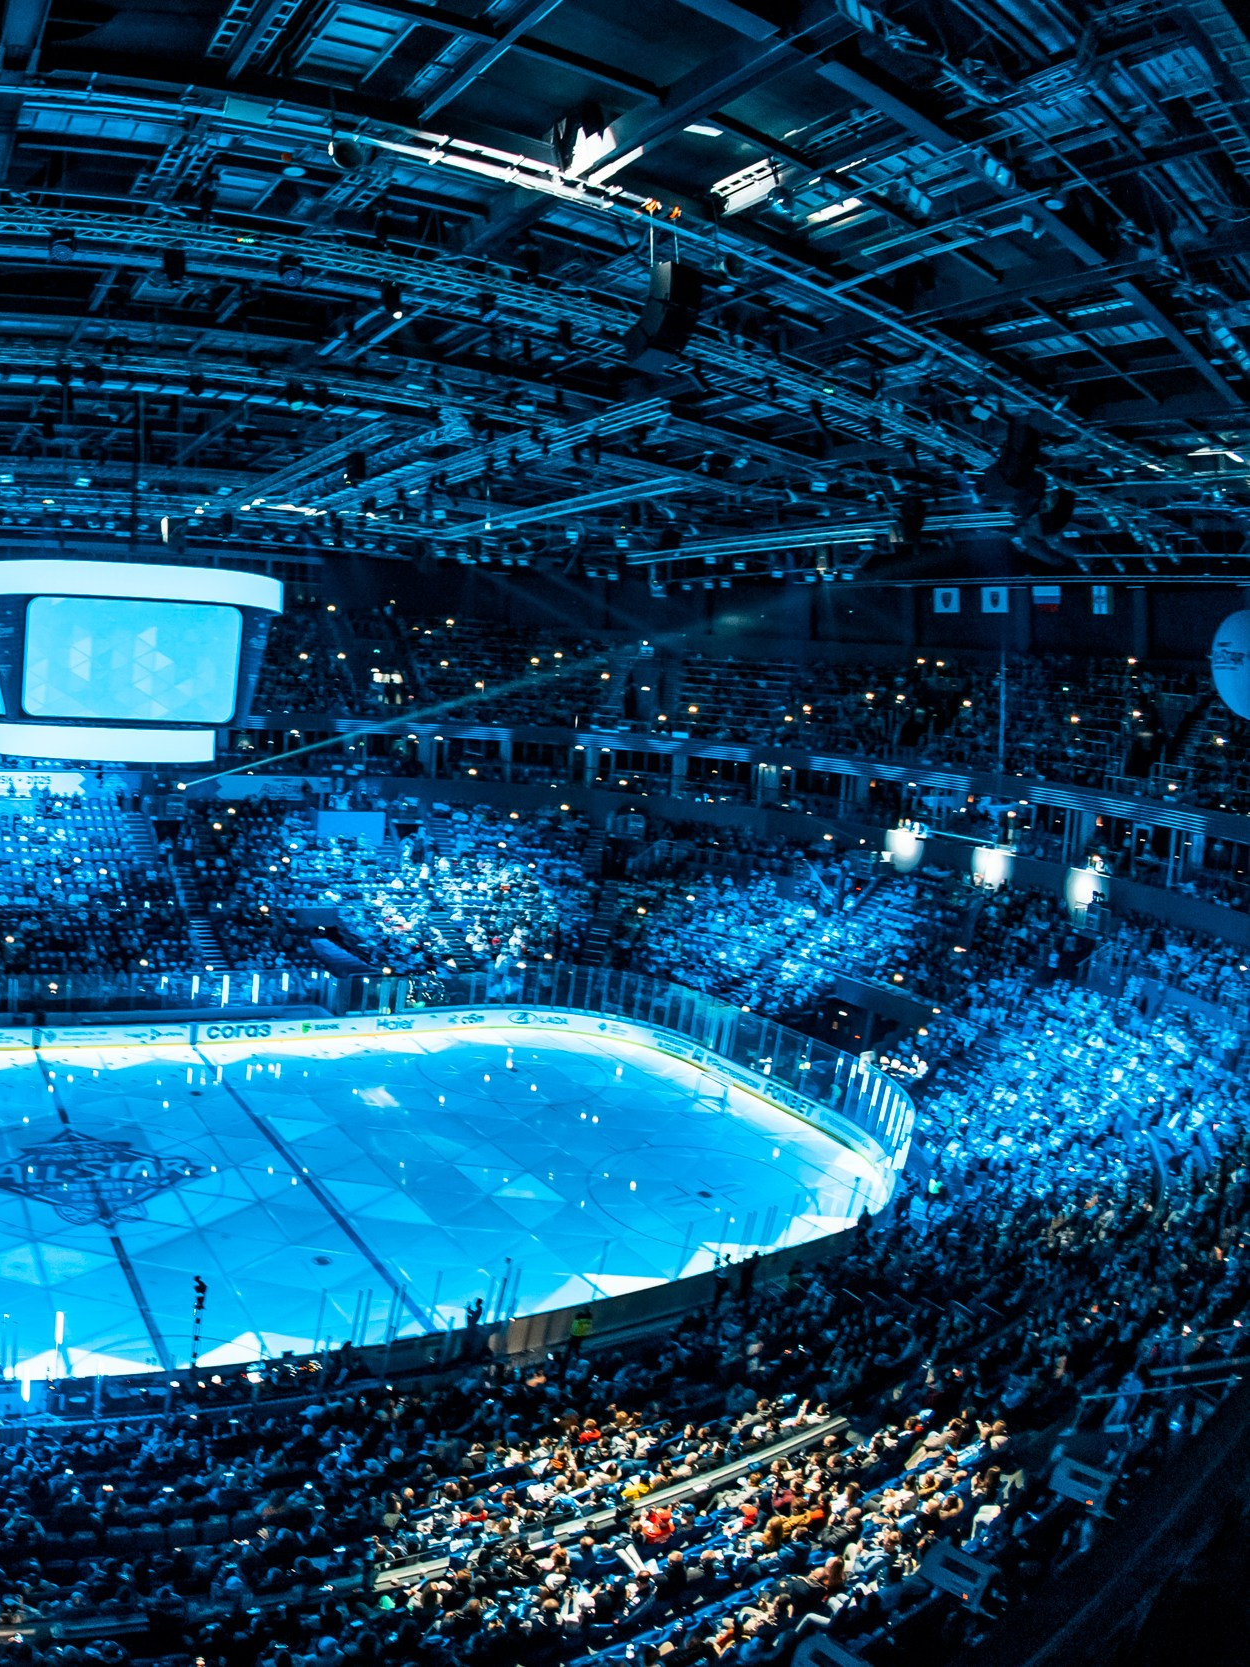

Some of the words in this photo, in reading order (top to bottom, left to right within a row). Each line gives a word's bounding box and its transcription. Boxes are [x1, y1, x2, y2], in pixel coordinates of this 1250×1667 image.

[376, 1018, 415, 1031] Haier
[764, 1082, 817, 1117] FONBET
[40, 1150, 116, 1161] FONBET
